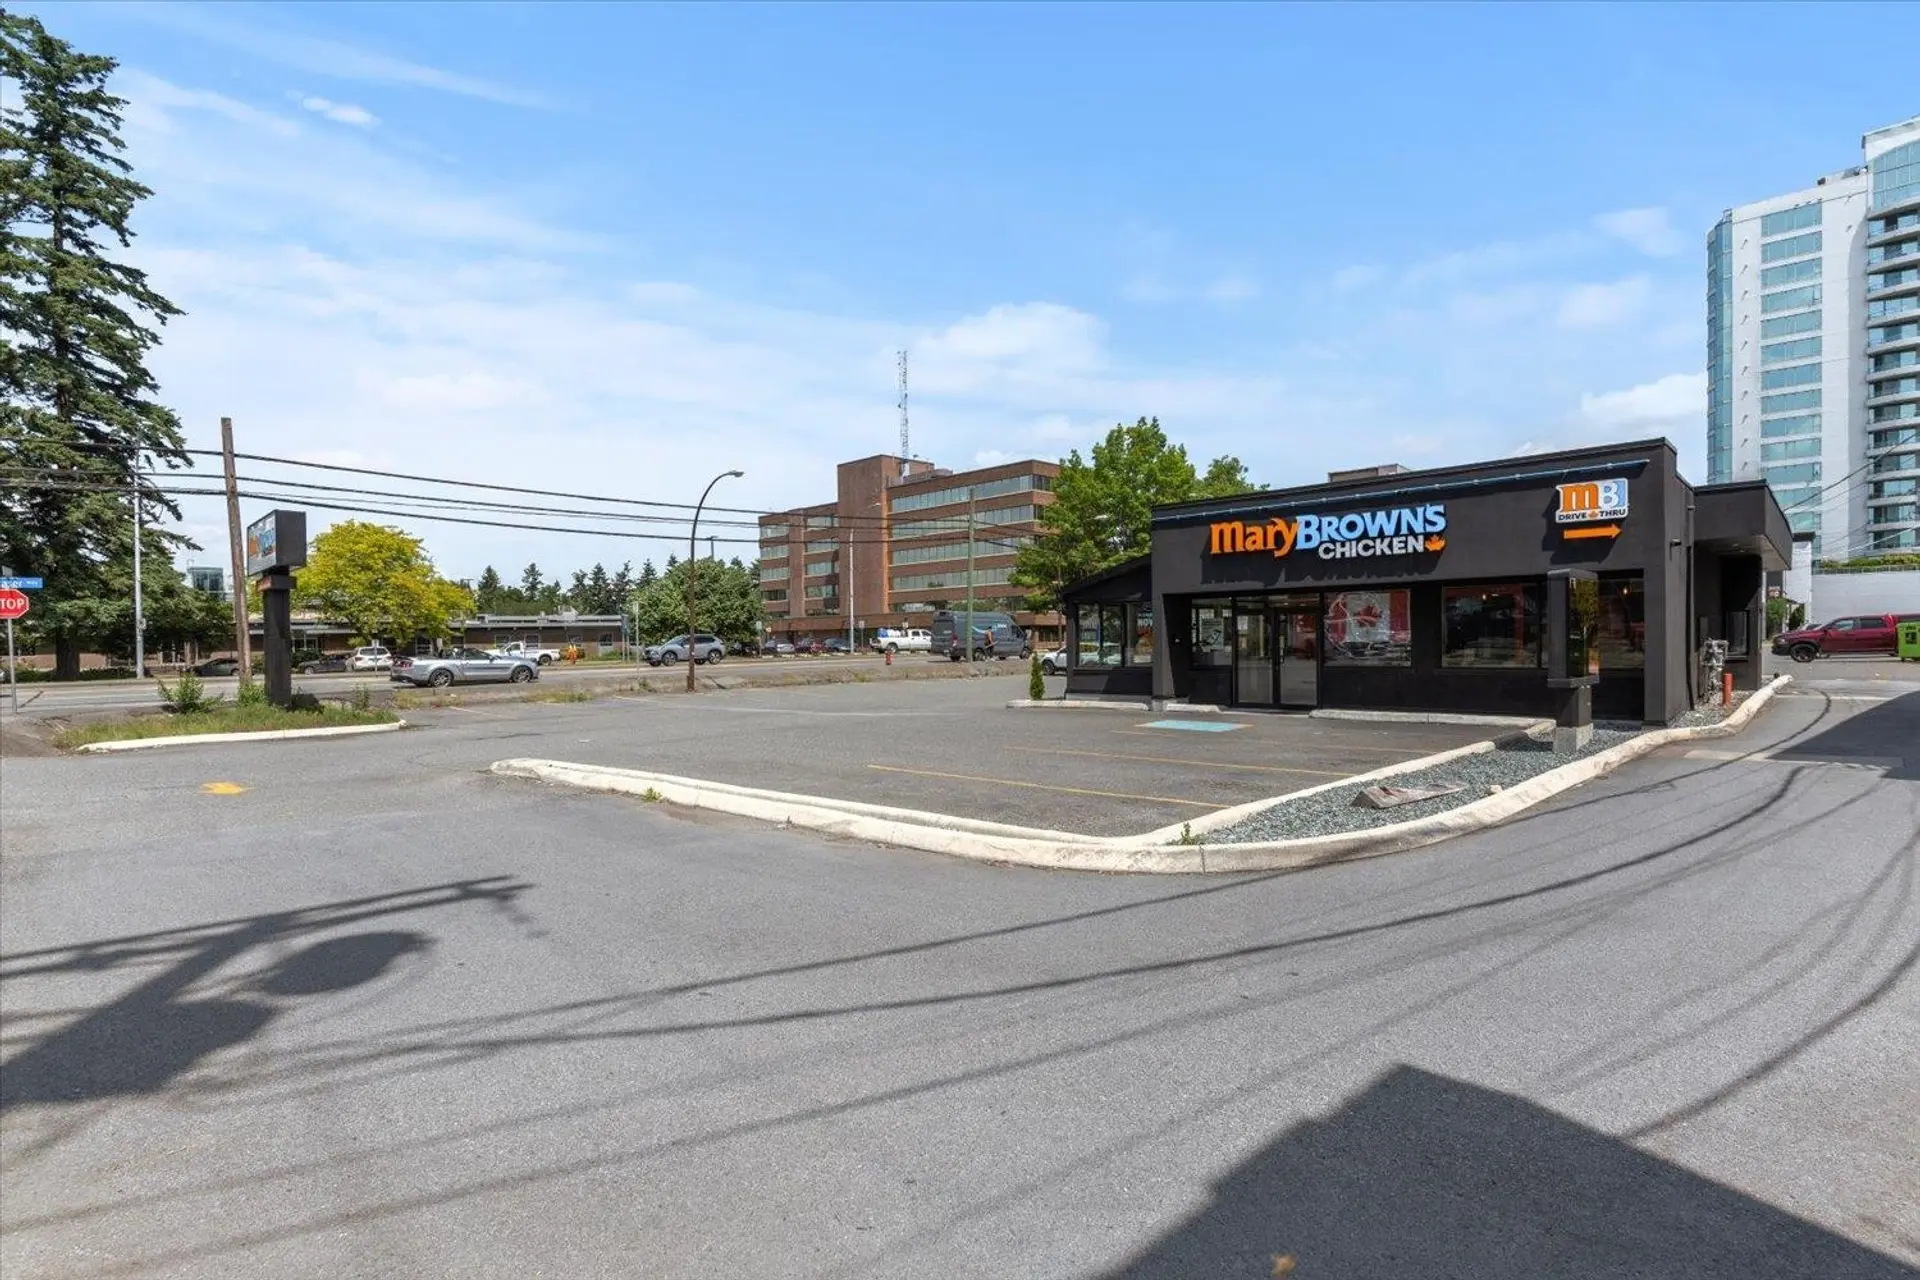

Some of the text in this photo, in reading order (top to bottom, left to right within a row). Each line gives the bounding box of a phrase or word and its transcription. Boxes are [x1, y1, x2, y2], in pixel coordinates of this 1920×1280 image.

[1558, 509, 1626, 521] DRIVE THRU
[1318, 534, 1424, 560] CHICKEN
[0, 598, 25, 610] TOP
